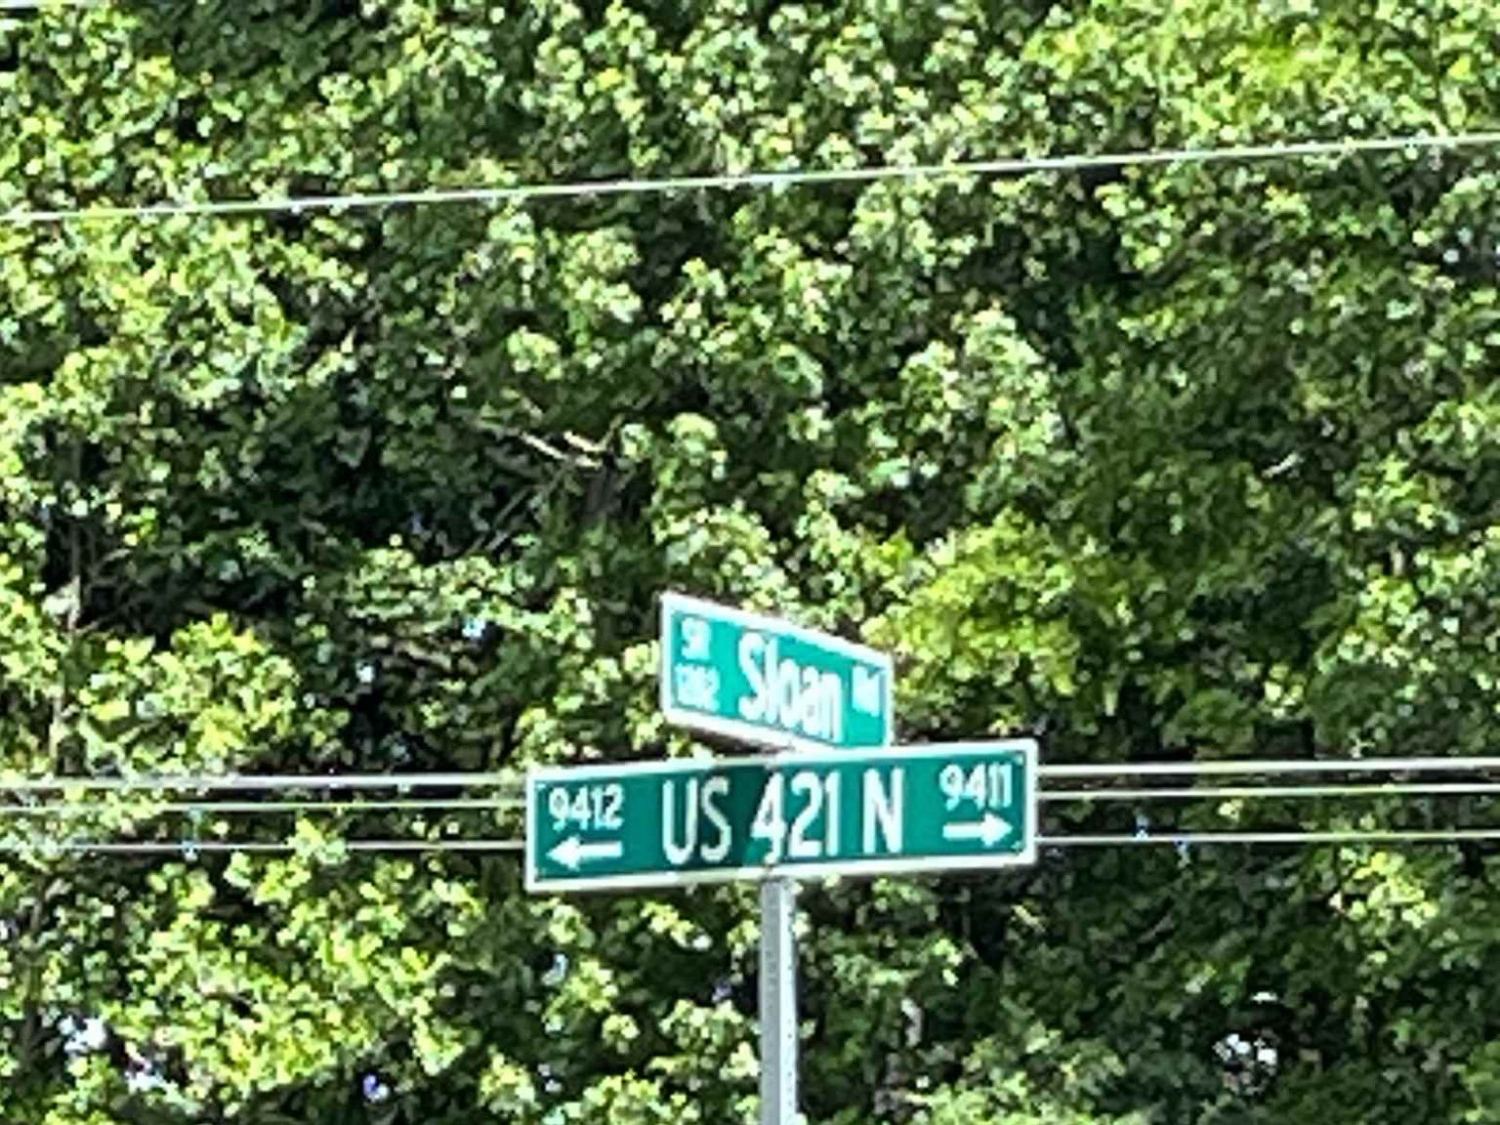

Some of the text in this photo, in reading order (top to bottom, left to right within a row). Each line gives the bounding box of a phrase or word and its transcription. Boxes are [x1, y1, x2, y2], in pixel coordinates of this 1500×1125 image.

[739, 632, 843, 744] Sloan
[547, 783, 624, 831] 9412
[662, 766, 904, 866] US 421 N
[940, 763, 1013, 812] 9411
